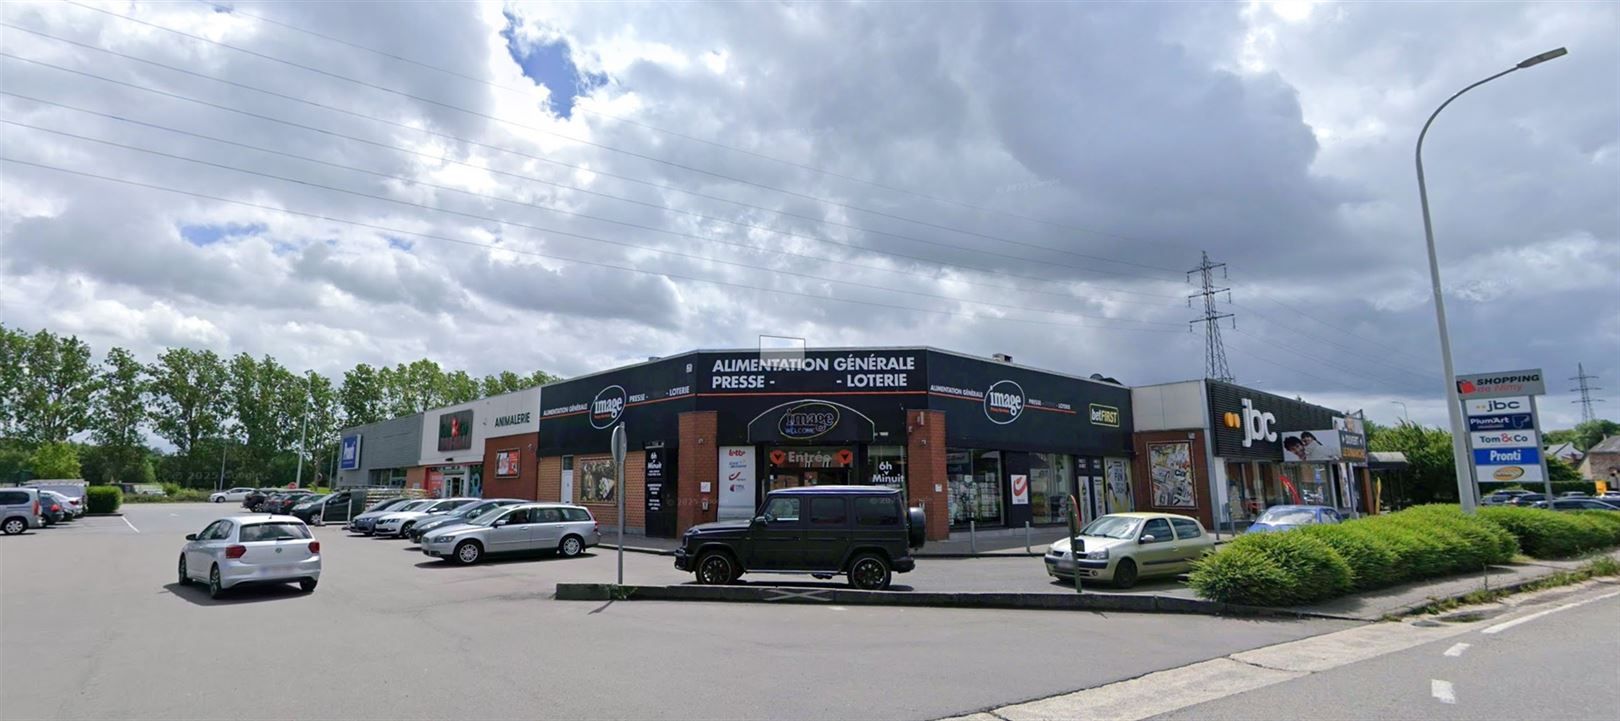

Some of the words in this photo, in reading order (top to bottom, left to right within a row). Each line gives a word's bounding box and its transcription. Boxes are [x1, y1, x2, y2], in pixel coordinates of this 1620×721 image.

[712, 357, 829, 372] ALIMENTATION
[833, 354, 915, 371] GÉNÉRALE
[712, 375, 765, 388] PRESSE
[847, 374, 907, 387] LOTERIE
[1477, 374, 1540, 386] SHOPPING
[629, 393, 645, 402] PRESSE
[669, 385, 690, 396] LOTERIE
[930, 384, 962, 395] ALIMENTATION
[594, 395, 623, 418] image
[989, 385, 1021, 416] image
[1486, 400, 1520, 412] jbc
[543, 405, 569, 417] ALIMENTATION
[1091, 407, 1117, 423] betFIRST
[494, 412, 531, 428] ANIMALERIE
[785, 408, 834, 432] image
[1241, 398, 1278, 448] jbc
[1489, 449, 1521, 462] Pronti
[879, 461, 892, 471] 6h
[872, 474, 905, 483] Minuit
